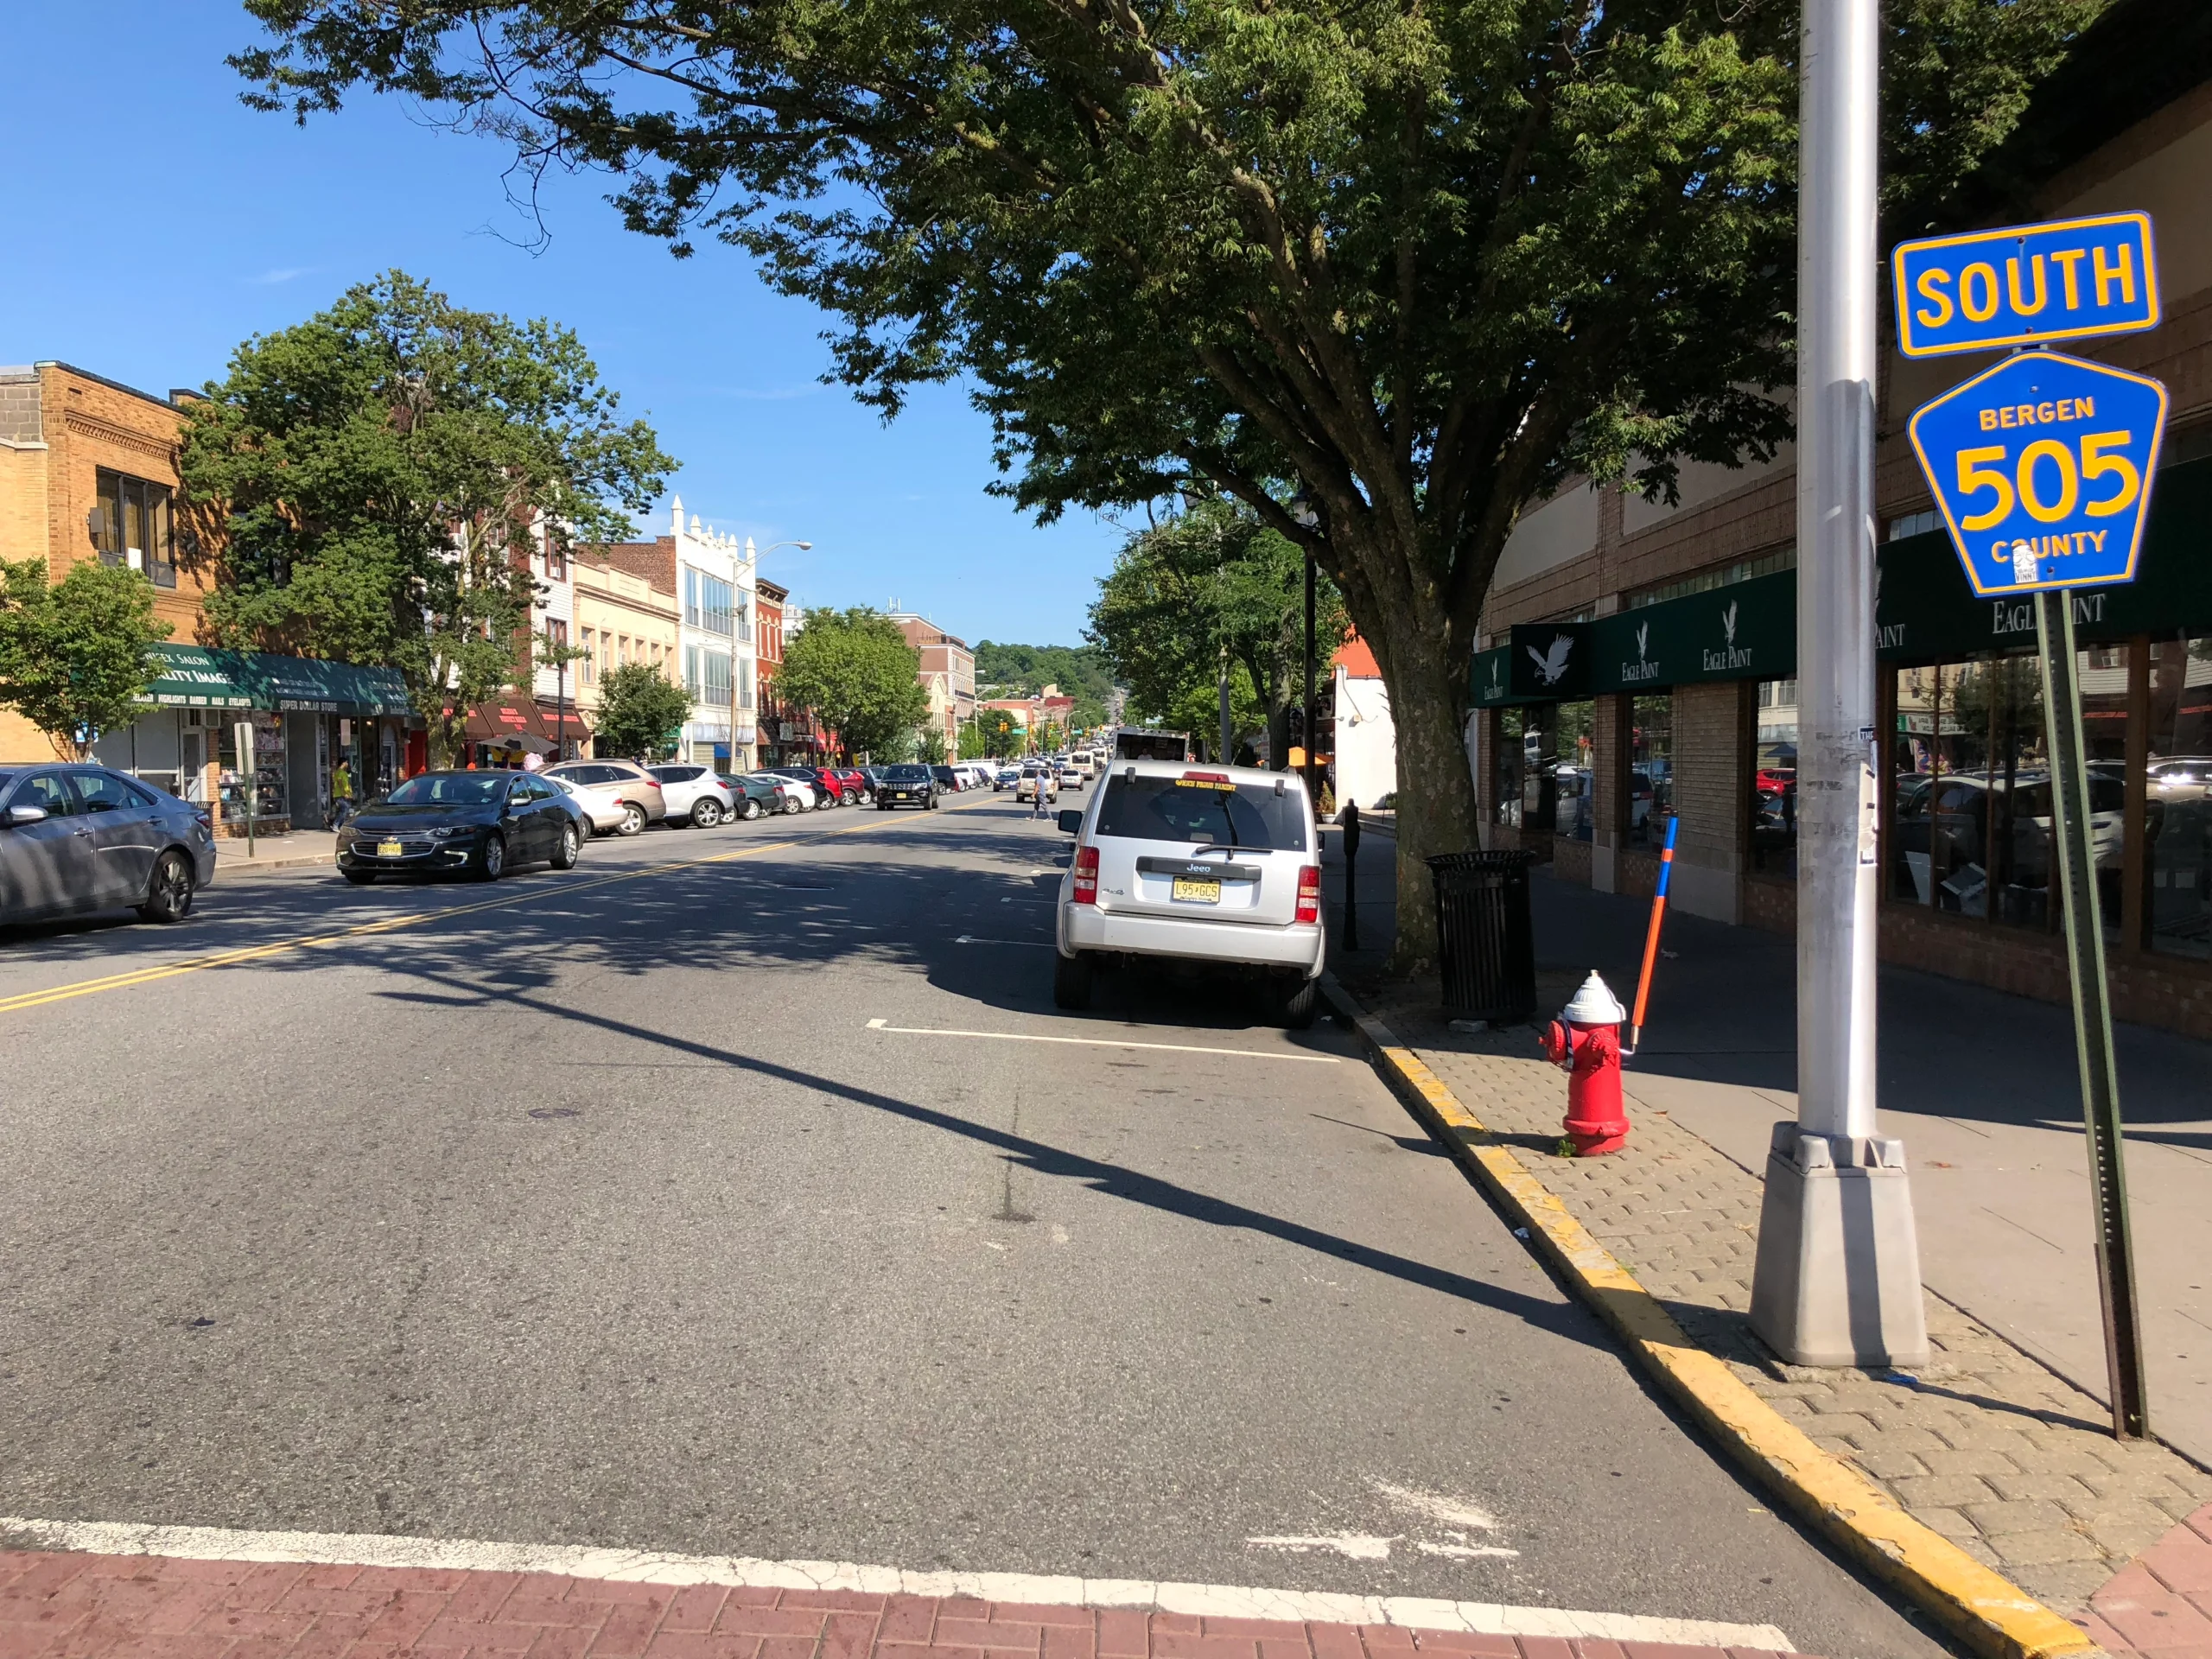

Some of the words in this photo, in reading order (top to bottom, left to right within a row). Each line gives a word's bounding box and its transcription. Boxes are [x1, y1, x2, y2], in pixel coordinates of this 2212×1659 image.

[1916, 243, 2136, 328] SOUTH
[1979, 397, 2096, 431] BERGEN
[1956, 430, 2139, 531] 505
[1992, 601, 2037, 634] EAGL
[2072, 593, 2106, 625] INT
[176, 653, 210, 666] SALON
[1703, 648, 1726, 671] EAGLE
[1728, 645, 1751, 668] PAINT
[192, 670, 234, 684] IMAGE
[1622, 662, 1640, 682] EAGLE
[1641, 659, 1659, 680] PAINT
[158, 694, 187, 705] HIGHLIGHTS
[189, 695, 207, 706] BARBER
[212, 696, 225, 707] NAILS
[280, 699, 298, 711] SUPER
[299, 700, 320, 712] DOLLAR
[321, 702, 337, 712] STORE
[1186, 863, 1211, 873] Jeep
